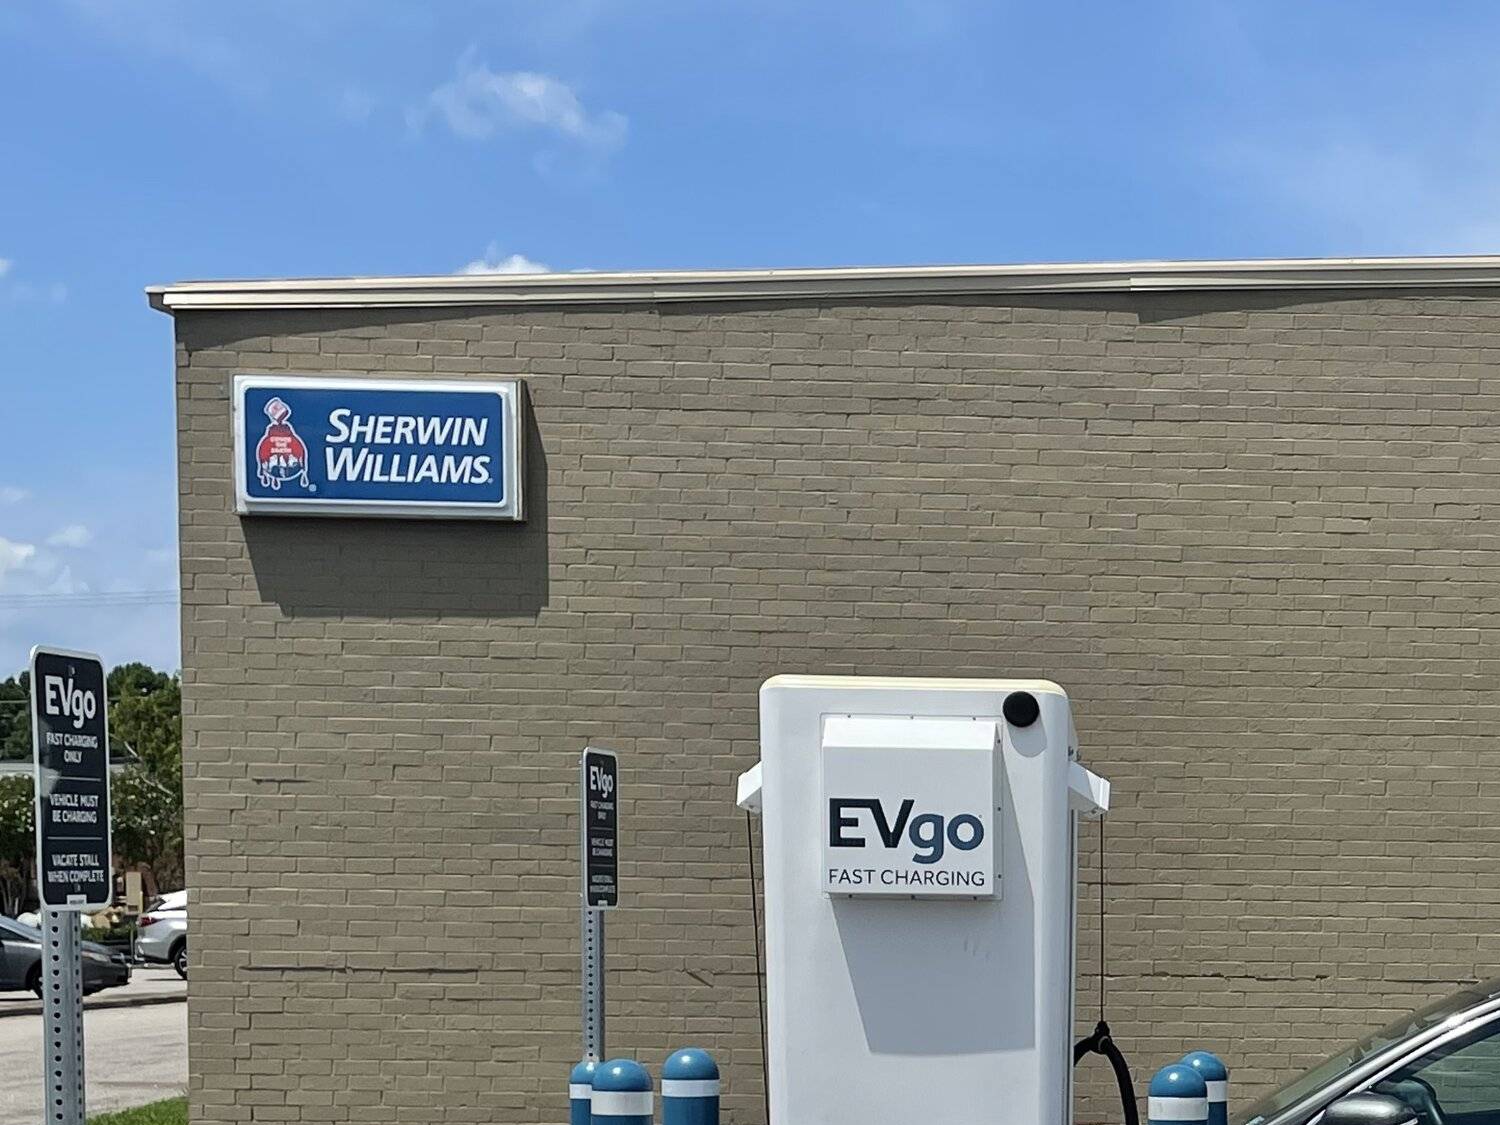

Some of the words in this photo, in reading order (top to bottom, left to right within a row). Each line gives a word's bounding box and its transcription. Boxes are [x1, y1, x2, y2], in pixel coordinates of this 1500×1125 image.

[325, 408, 489, 446] SHERWIN
[324, 447, 491, 485] WILLIAMS
[44, 675, 97, 729] EVgo
[46, 732, 63, 746] FAST
[64, 733, 98, 748] CHARGING
[63, 750, 83, 763] ONLY
[589, 765, 614, 799] EVgo
[49, 793, 79, 807] VEHICLE
[79, 794, 99, 808] MUST
[52, 809, 62, 822] BE
[62, 809, 97, 823] CHARGING
[829, 797, 985, 865] EVgo
[51, 853, 78, 867] VACATE
[79, 853, 100, 867] STALL
[69, 870, 105, 884] COMPLETE
[828, 868, 876, 885] FAST
[880, 869, 985, 887] CHARGING
